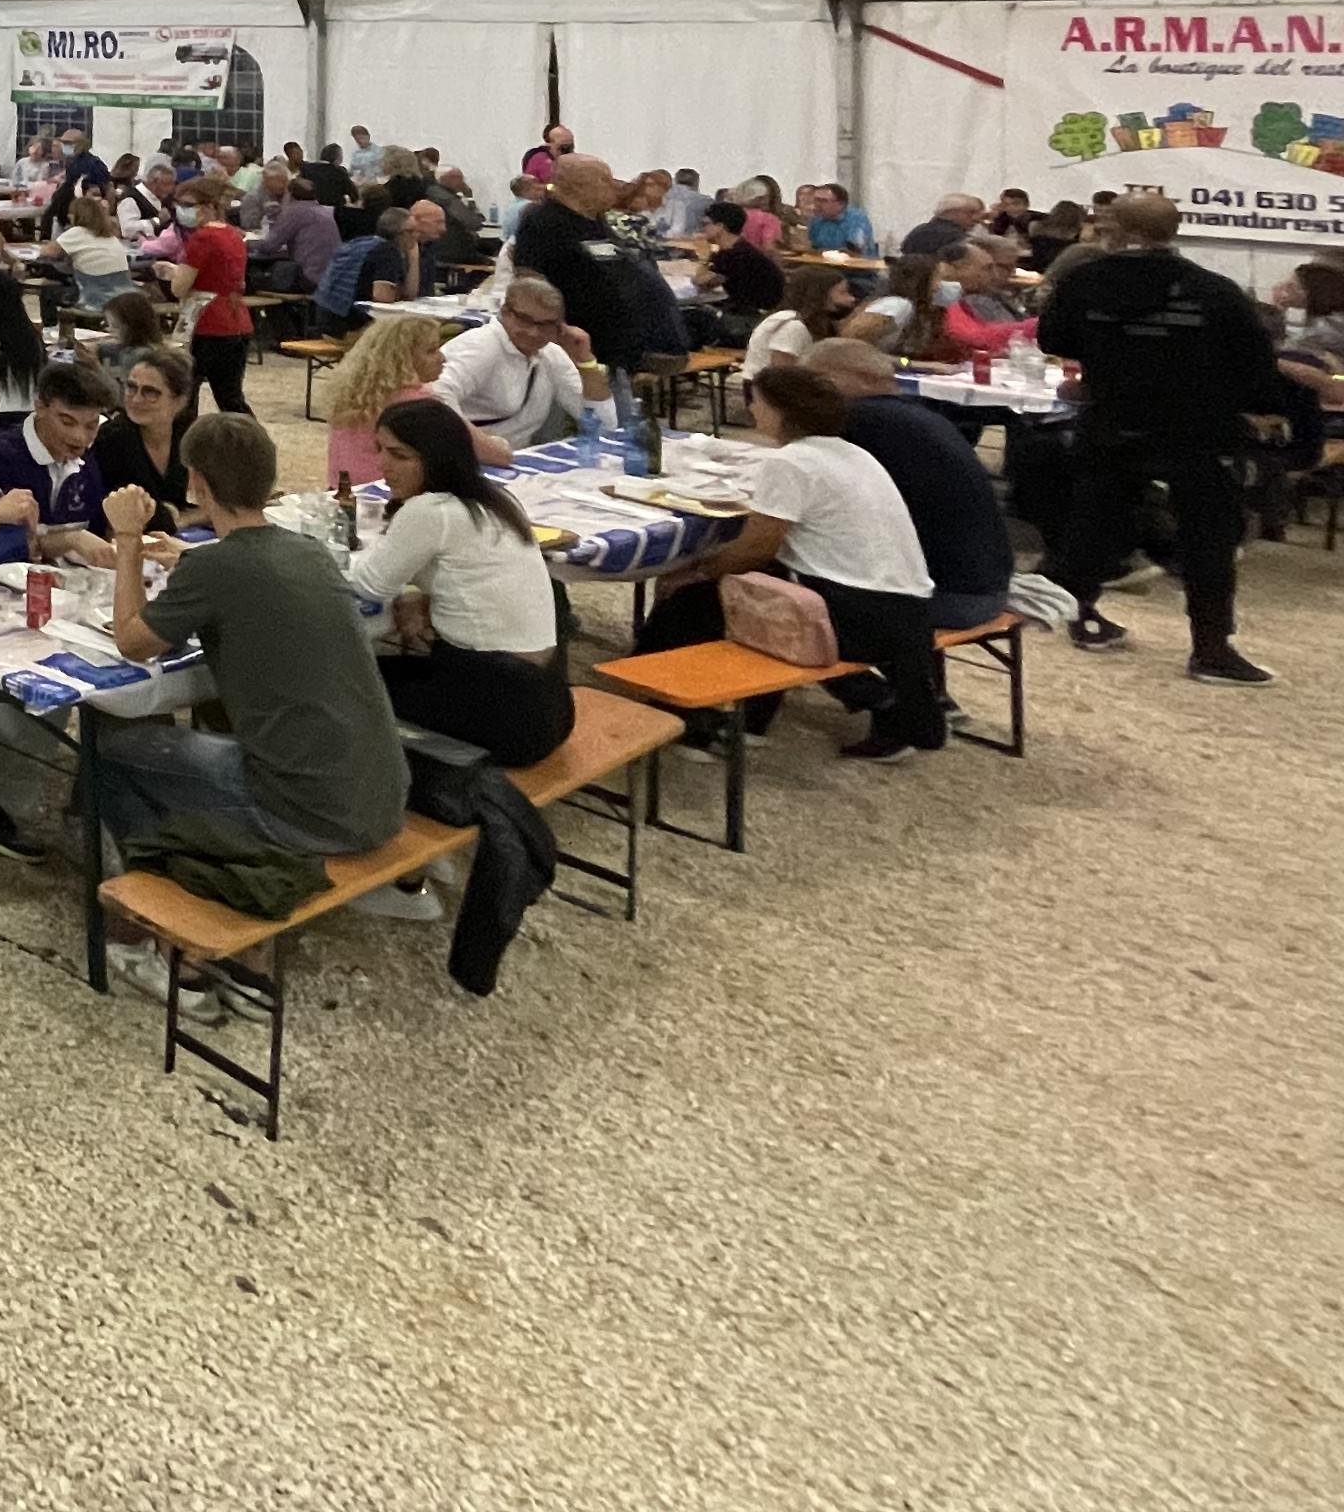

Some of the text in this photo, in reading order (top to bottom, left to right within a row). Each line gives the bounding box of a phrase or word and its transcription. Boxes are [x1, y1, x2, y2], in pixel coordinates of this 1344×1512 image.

[1148, 56, 1244, 81] boutique
[1254, 58, 1293, 76] del
[1191, 188, 1245, 207] 041
[1256, 191, 1317, 211] 630
